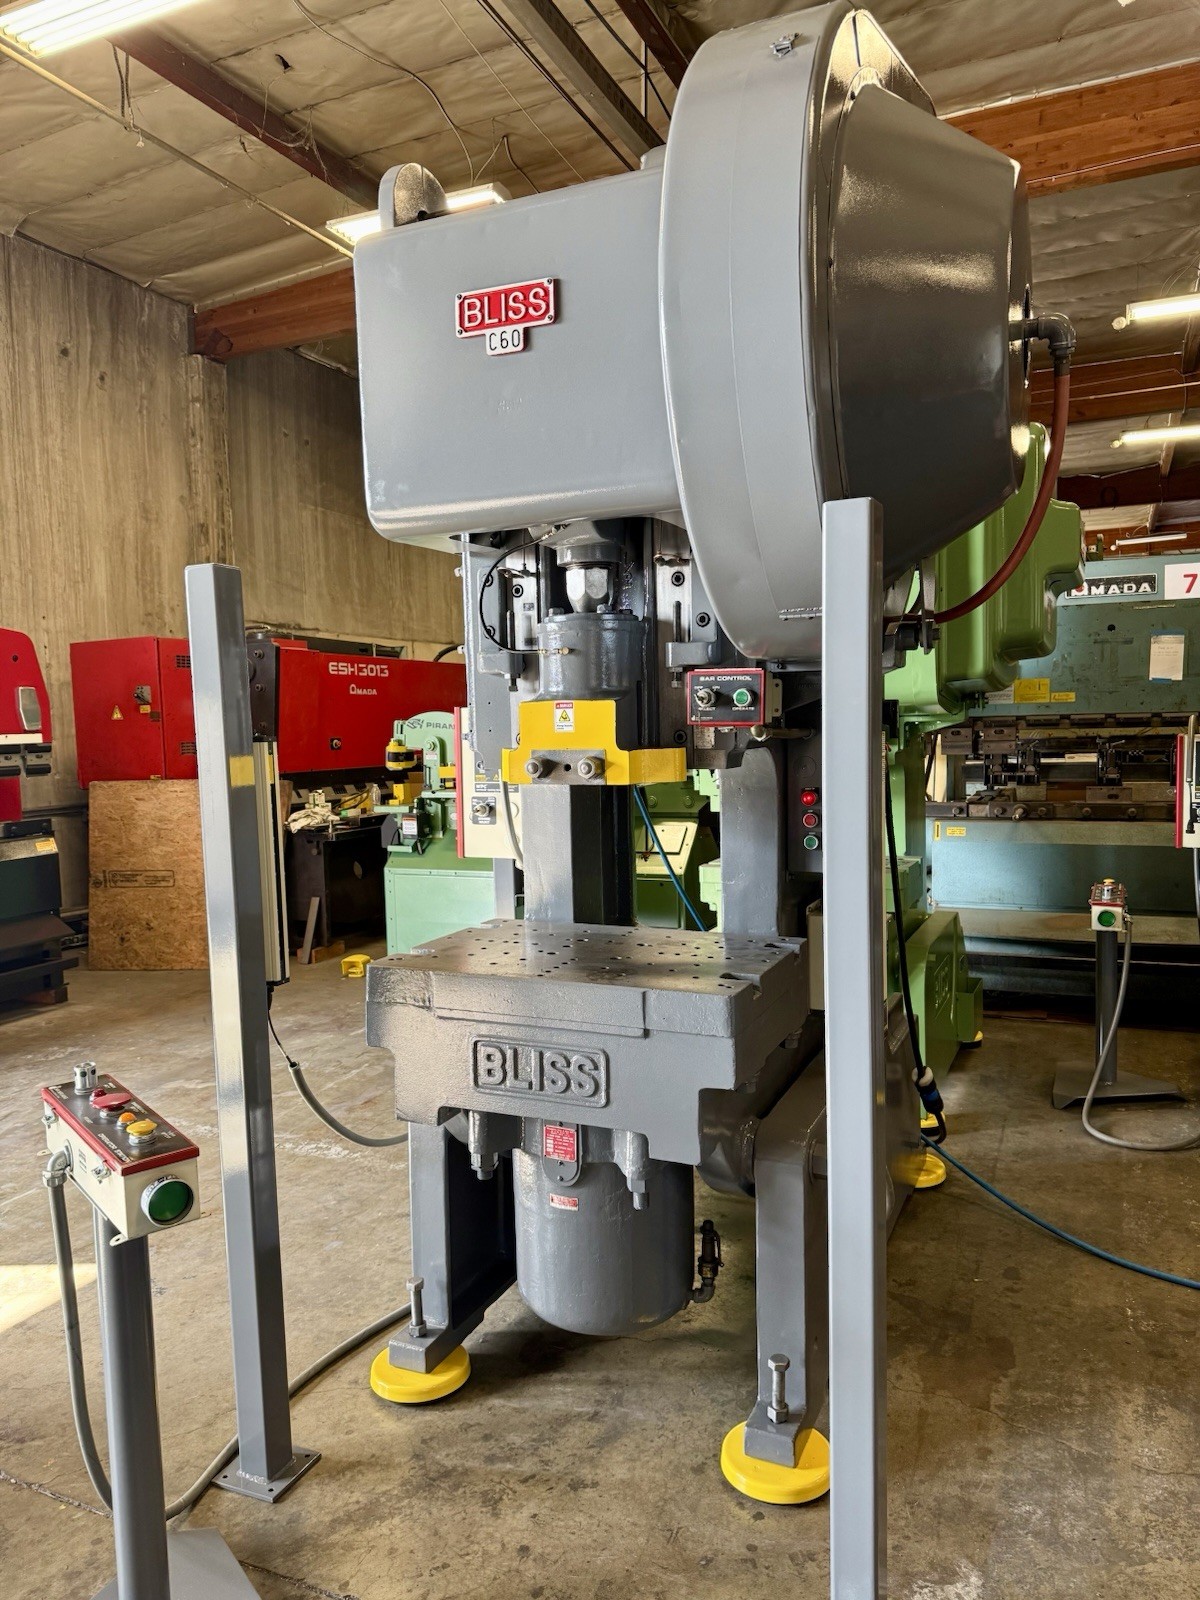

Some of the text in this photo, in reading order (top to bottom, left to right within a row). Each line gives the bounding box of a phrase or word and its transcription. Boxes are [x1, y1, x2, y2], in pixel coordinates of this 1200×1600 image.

[463, 287, 547, 328] BLISS
[488, 328, 521, 351] C60
[1183, 573, 1198, 594] 7
[328, 661, 389, 677] ESH3013
[478, 1041, 600, 1098] BLISS
